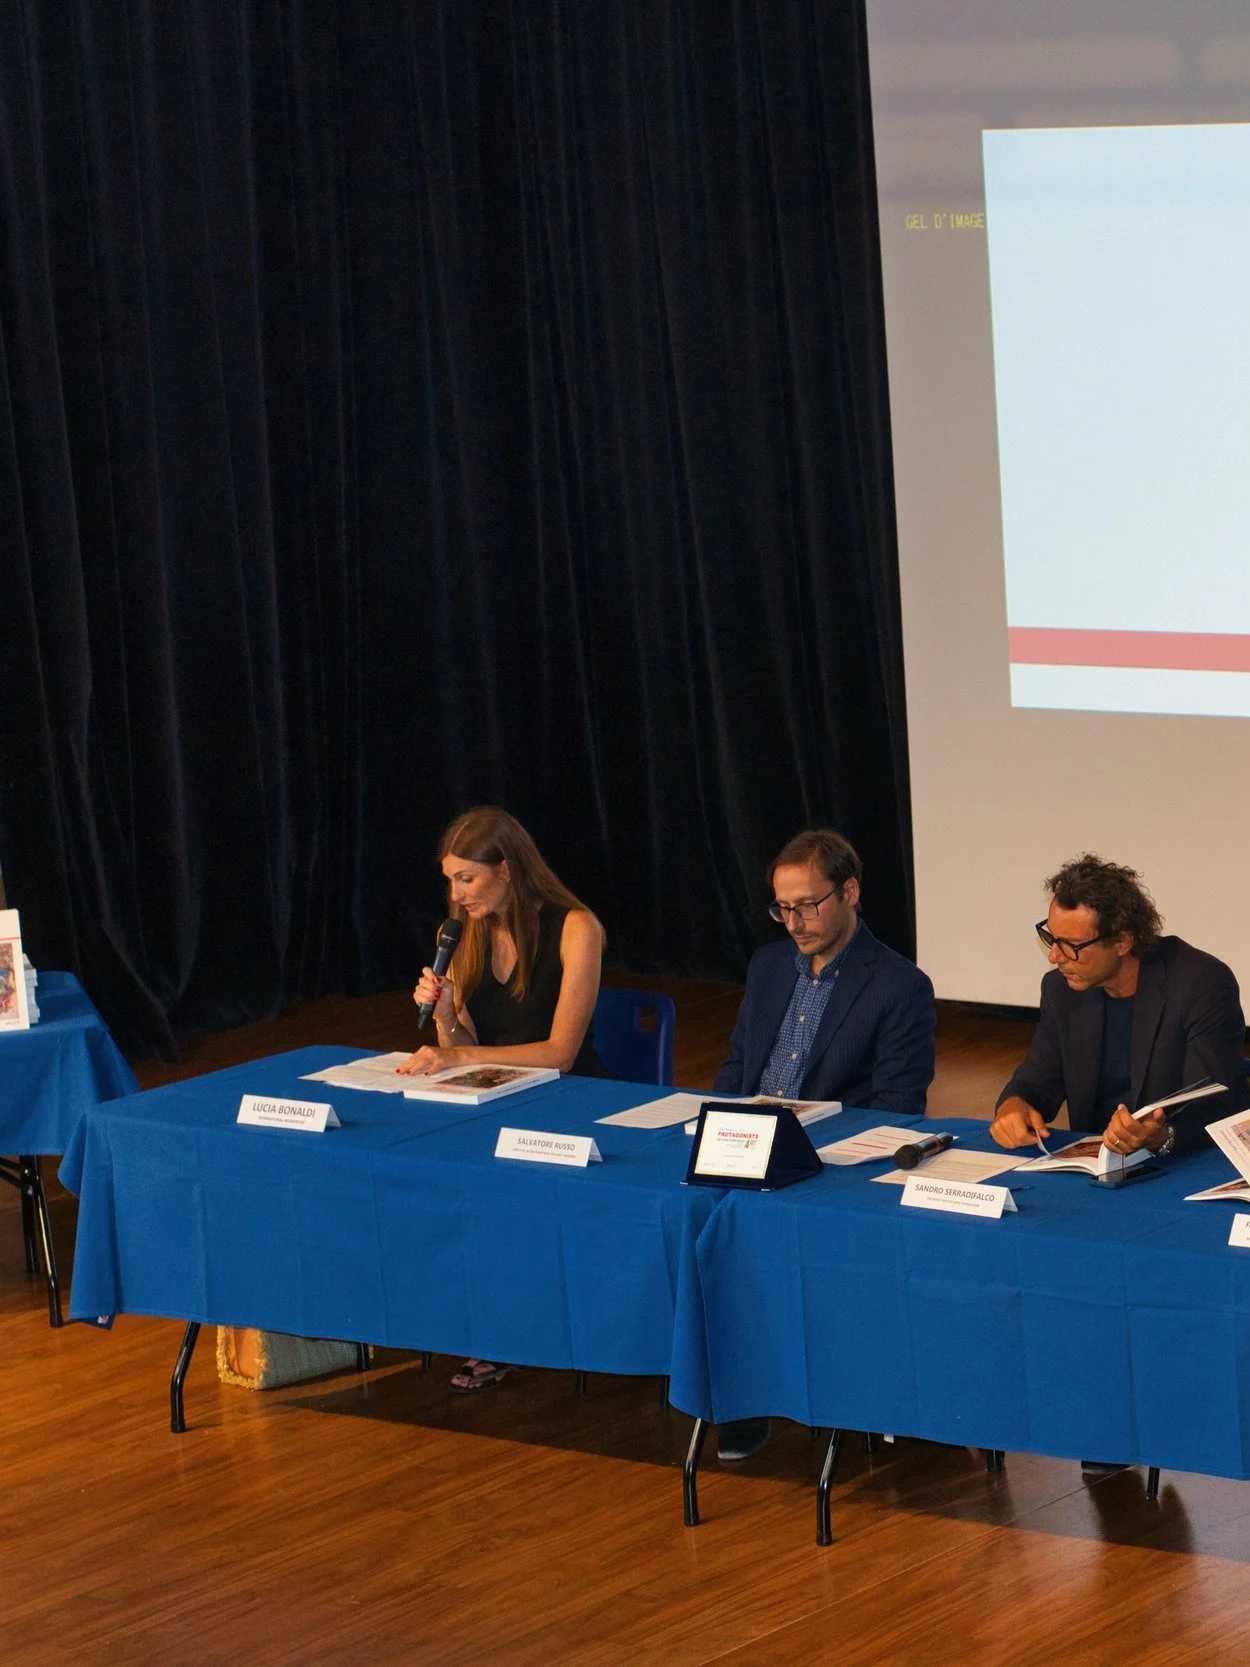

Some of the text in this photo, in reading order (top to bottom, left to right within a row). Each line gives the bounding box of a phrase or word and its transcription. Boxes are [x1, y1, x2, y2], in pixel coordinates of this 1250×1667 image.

[906, 214, 928, 229] GEL
[252, 1102, 316, 1117] LUCIA BONALDI
[517, 1138, 576, 1151] SALVATORE RUSSO
[915, 1184, 943, 1194] SANDRO
[944, 1188, 995, 1202] SERRADIFALCO
